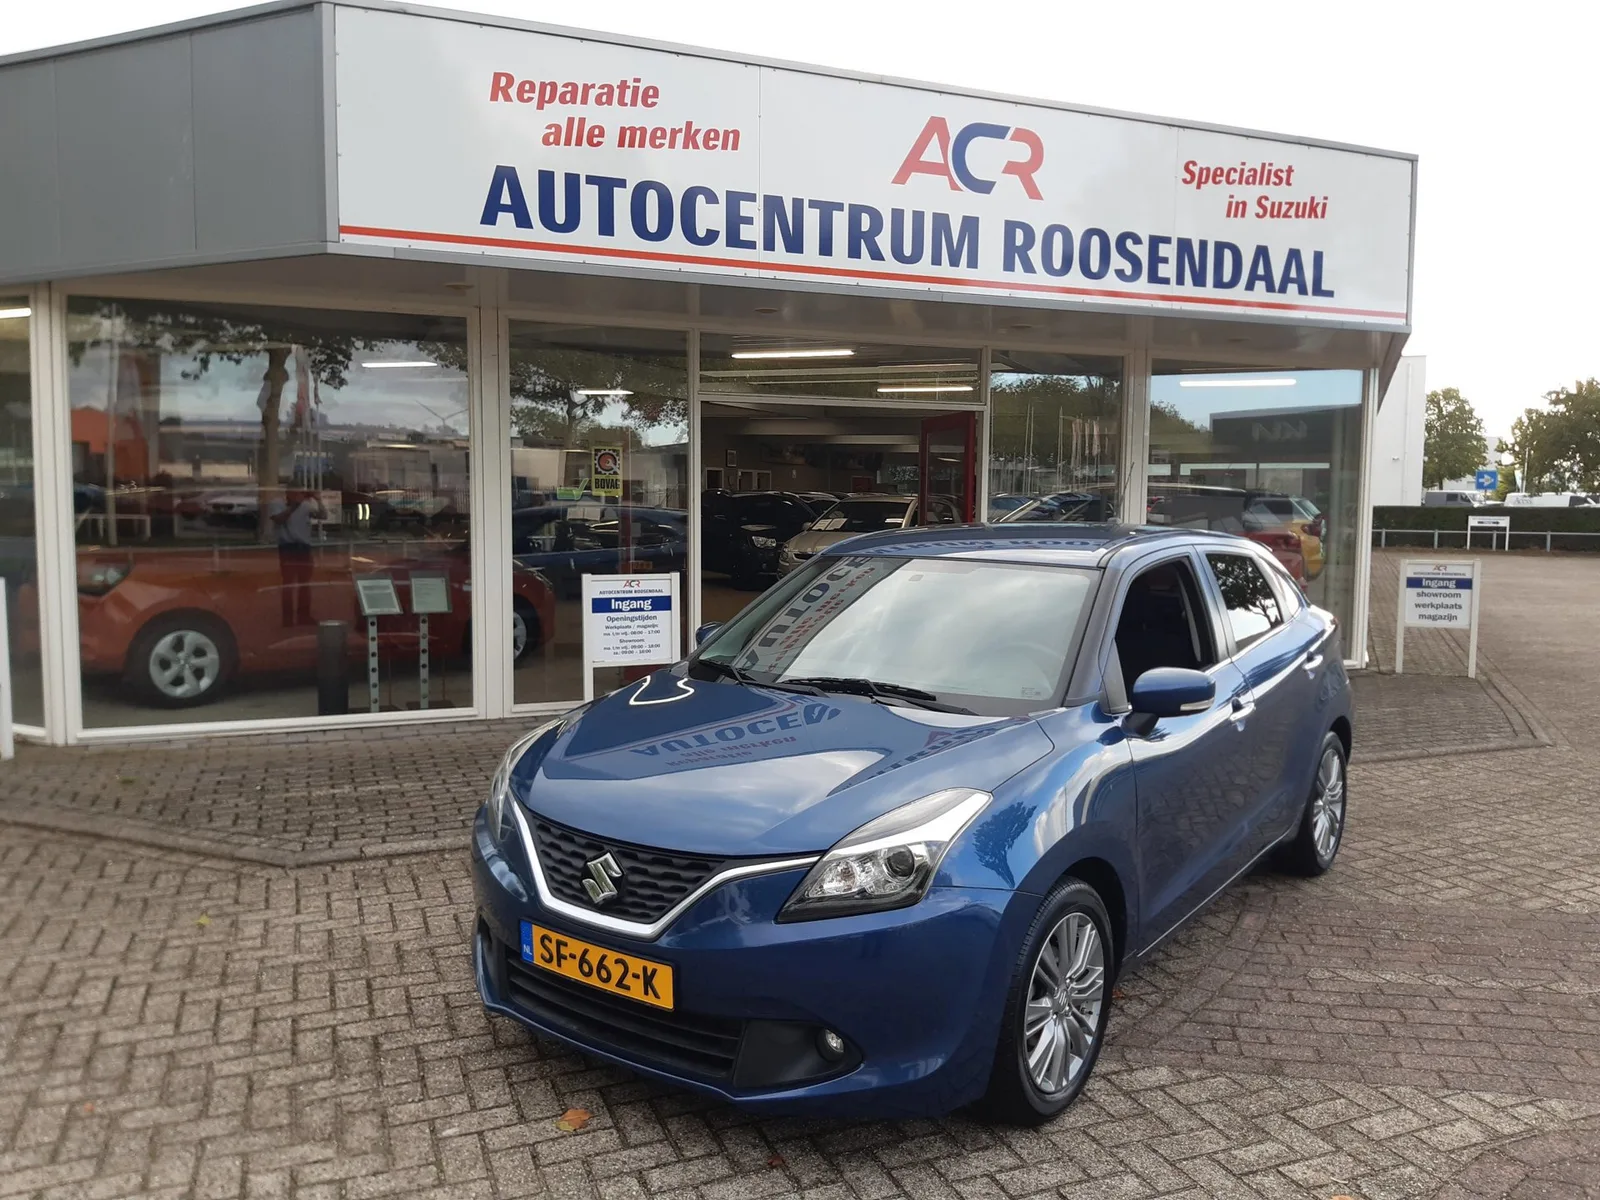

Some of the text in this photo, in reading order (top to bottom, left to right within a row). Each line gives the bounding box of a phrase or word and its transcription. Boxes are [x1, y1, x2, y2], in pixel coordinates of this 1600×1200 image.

[489, 72, 659, 111] Reparatie
[541, 117, 741, 152] alle merken
[891, 116, 1044, 200] ACR
[1181, 160, 1294, 190] Specialist
[1225, 195, 1328, 219] in Suzuki
[480, 164, 1335, 298] AUTOCENTRUM ROOSENDAAL
[594, 478, 620, 489] BOVAG
[623, 580, 641, 588] ACR
[1422, 578, 1456, 588] Ingang
[611, 598, 652, 611] Ingang
[1414, 602, 1463, 610] werkplaats
[606, 614, 657, 623] Openingstijden
[1418, 613, 1458, 622] magazijn
[523, 944, 532, 955] NL
[540, 933, 661, 1000] SF-662-K
